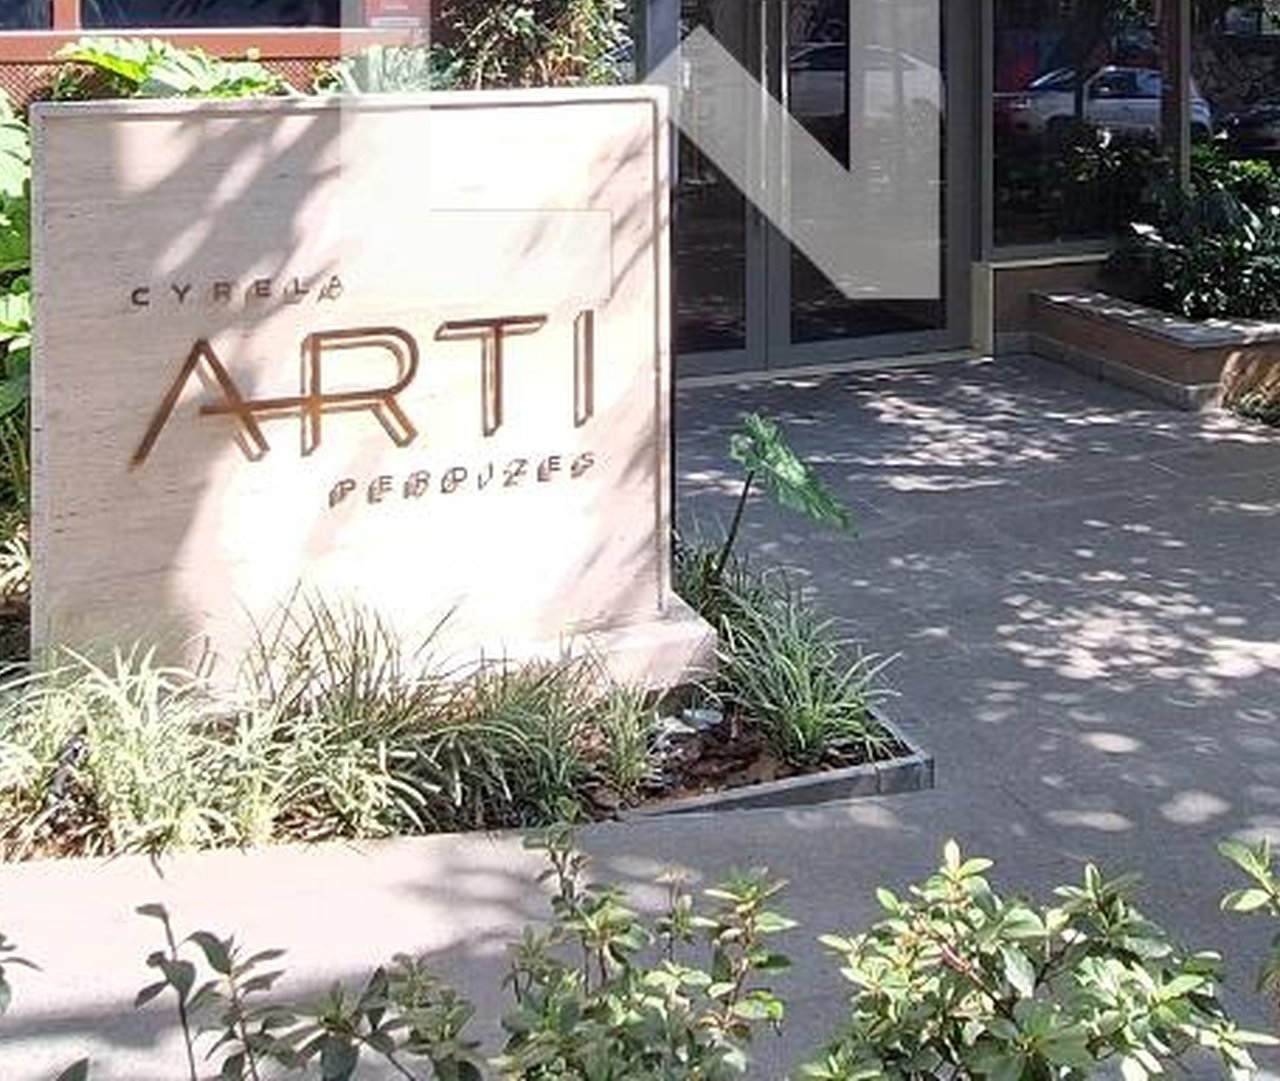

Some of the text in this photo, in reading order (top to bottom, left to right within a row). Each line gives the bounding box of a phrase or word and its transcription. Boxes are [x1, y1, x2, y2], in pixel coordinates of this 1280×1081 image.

[130, 275, 343, 307] CYRELA
[128, 309, 595, 472] ARTI
[328, 451, 596, 509] PERDIZES
